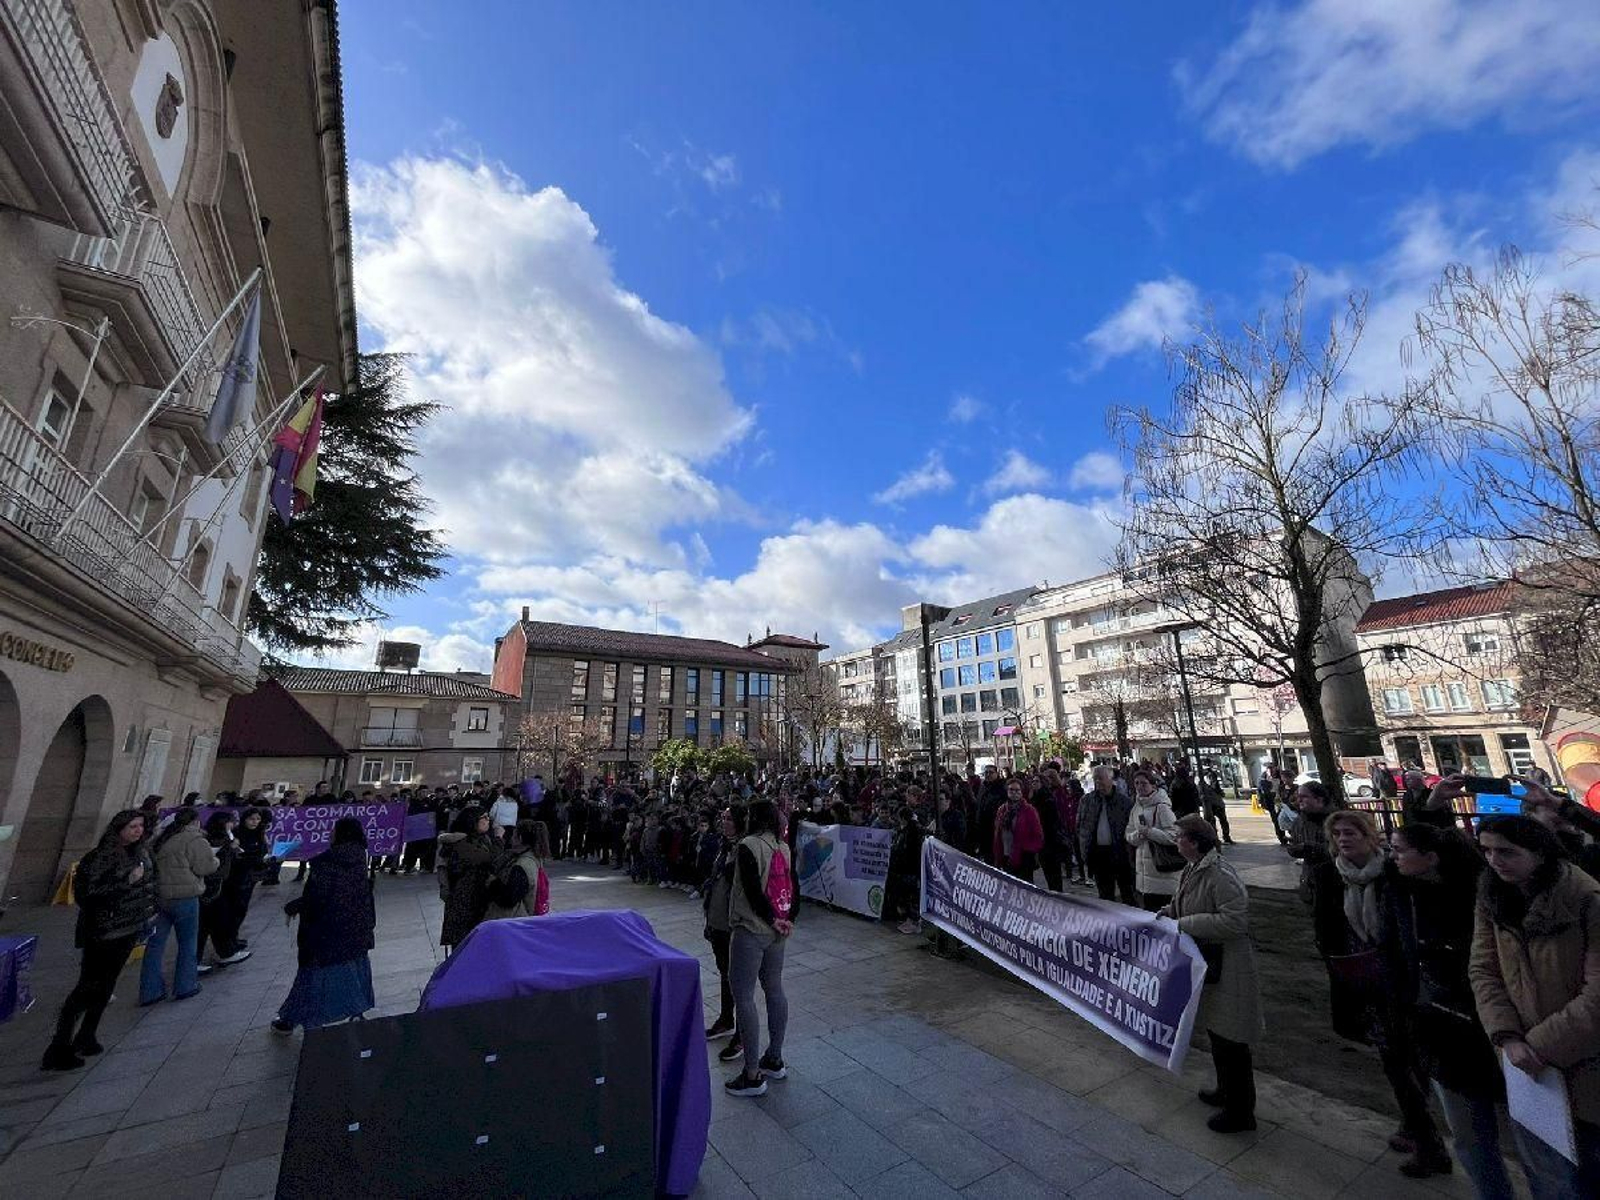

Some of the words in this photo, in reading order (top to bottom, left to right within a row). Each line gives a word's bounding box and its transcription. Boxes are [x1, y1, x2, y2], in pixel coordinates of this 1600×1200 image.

[292, 818, 338, 832] CONT
[305, 804, 389, 818] COMARCA
[310, 831, 331, 844] DE
[367, 827, 399, 840] ERO
[952, 885, 993, 922] CONTRA
[993, 905, 1003, 928] A
[1003, 910, 1068, 962] VIOLENCIA
[1072, 939, 1094, 973] DE
[1098, 950, 1161, 1008] XÉNERO
[953, 863, 998, 897] FEMURO
[1008, 884, 1027, 909] AS
[1062, 907, 1171, 973] ASOCIACIÓNS
[1019, 946, 1045, 975] POLA
[1045, 959, 1104, 1009] IGUALDADE
[1105, 993, 1114, 1014] E
[1114, 998, 1122, 1021] A
[1124, 1003, 1175, 1048] XUSTIZ
